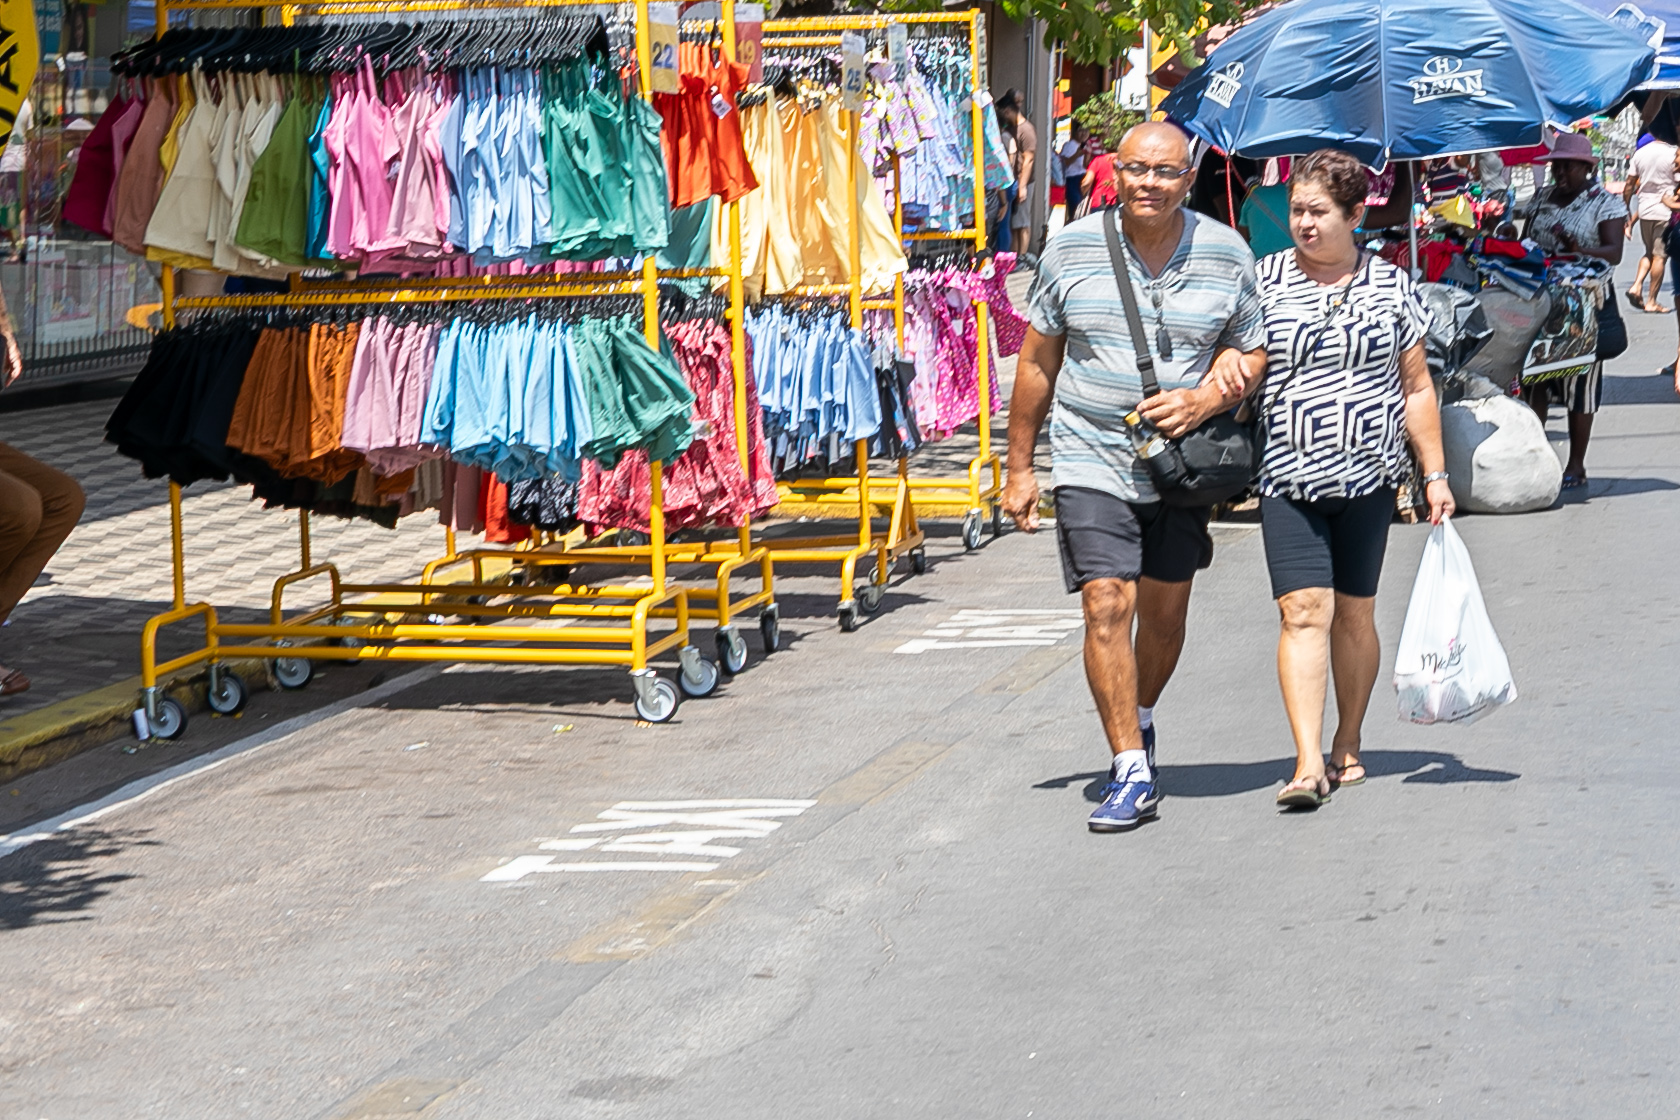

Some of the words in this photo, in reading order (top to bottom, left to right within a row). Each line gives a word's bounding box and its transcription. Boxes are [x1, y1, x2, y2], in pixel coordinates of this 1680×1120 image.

[651, 41, 674, 68] 22
[737, 39, 755, 65] 19
[846, 68, 862, 92] 25
[1411, 74, 1484, 99] HAVAN
[480, 798, 818, 882] TAXI
